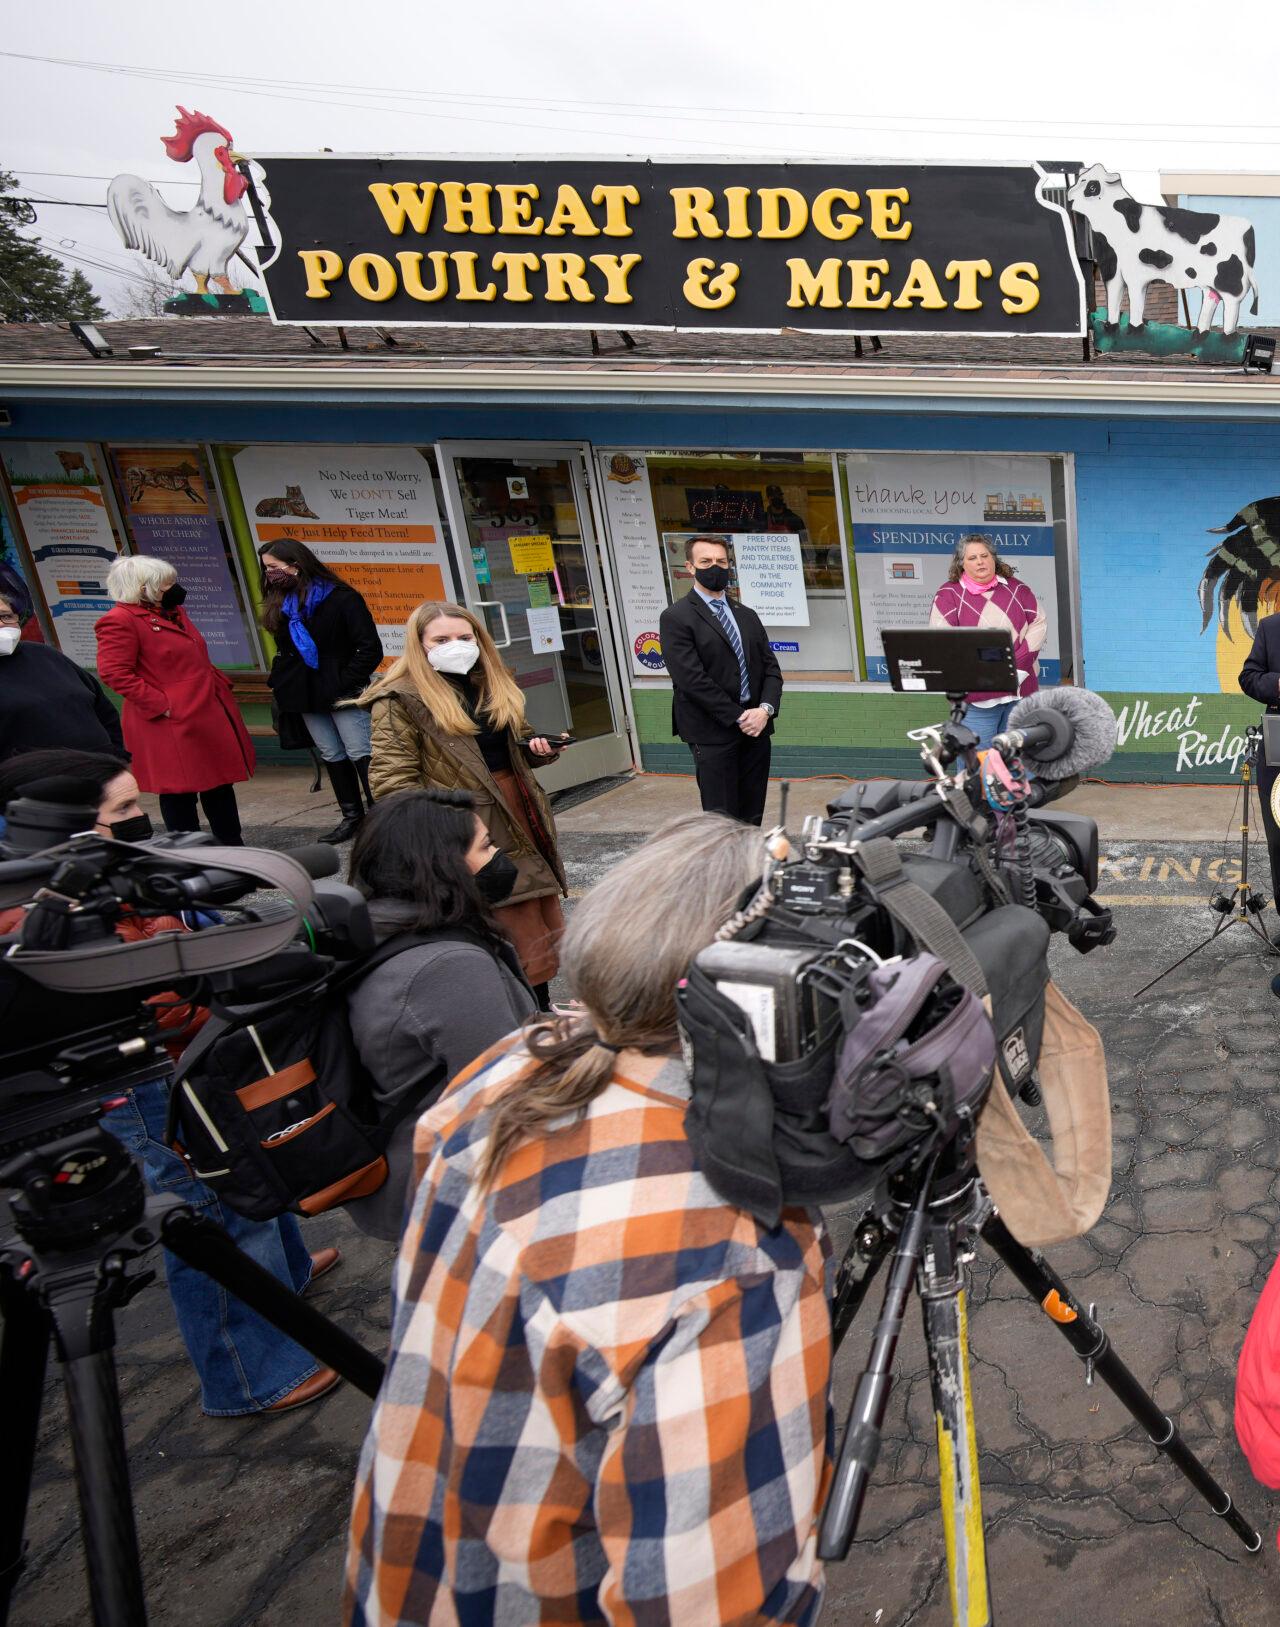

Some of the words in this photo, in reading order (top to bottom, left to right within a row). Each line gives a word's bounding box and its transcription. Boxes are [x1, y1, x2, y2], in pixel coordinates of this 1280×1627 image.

[367, 181, 643, 238] WHEAT
[670, 187, 913, 242] RIDGE
[297, 249, 643, 306] POULTRY
[682, 258, 741, 310] &
[786, 258, 1042, 316] MEATS
[318, 470, 337, 481] No
[340, 470, 370, 481] Need
[372, 472, 383, 481] to
[384, 470, 422, 484] Worry,
[329, 489, 348, 500] We
[351, 489, 393, 500] DON'T
[397, 489, 416, 501] Sell
[855, 484, 927, 505] thank
[934, 489, 977, 515] you
[345, 507, 375, 521] Tiger
[378, 507, 409, 519] Meat!
[691, 501, 757, 521] OPEN
[876, 507, 912, 515] CHOOSING
[139, 516, 175, 525] WHOLE
[174, 516, 209, 526] ANIMAL
[152, 529, 201, 538] BUTCHERY
[282, 527, 301, 537] We
[301, 527, 320, 539] Just
[323, 527, 348, 540] Help
[351, 528, 374, 538] Feed
[373, 528, 410, 539] Them!
[872, 531, 955, 545] SPENDING
[746, 535, 766, 543] FREE
[766, 535, 788, 543] FOOD
[320, 549, 348, 557] normally
[360, 549, 385, 557] dumped
[399, 549, 421, 557] landfill
[757, 554, 795, 562] TOILETRIES
[362, 565, 397, 574] Signature
[416, 565, 425, 574] of
[740, 563, 775, 571] AVAILABLE
[776, 563, 800, 571] INSIDE
[349, 577, 361, 585] Pet
[363, 577, 382, 585] Food
[384, 591, 425, 599] Sanctuaries
[760, 590, 785, 598] FRIDGE
[369, 603, 394, 612] Tigers
[635, 633, 660, 649] COLORA
[773, 642, 798, 652] Cream
[1175, 724, 1250, 775] Ridg
[790, 884, 816, 893] SONY
